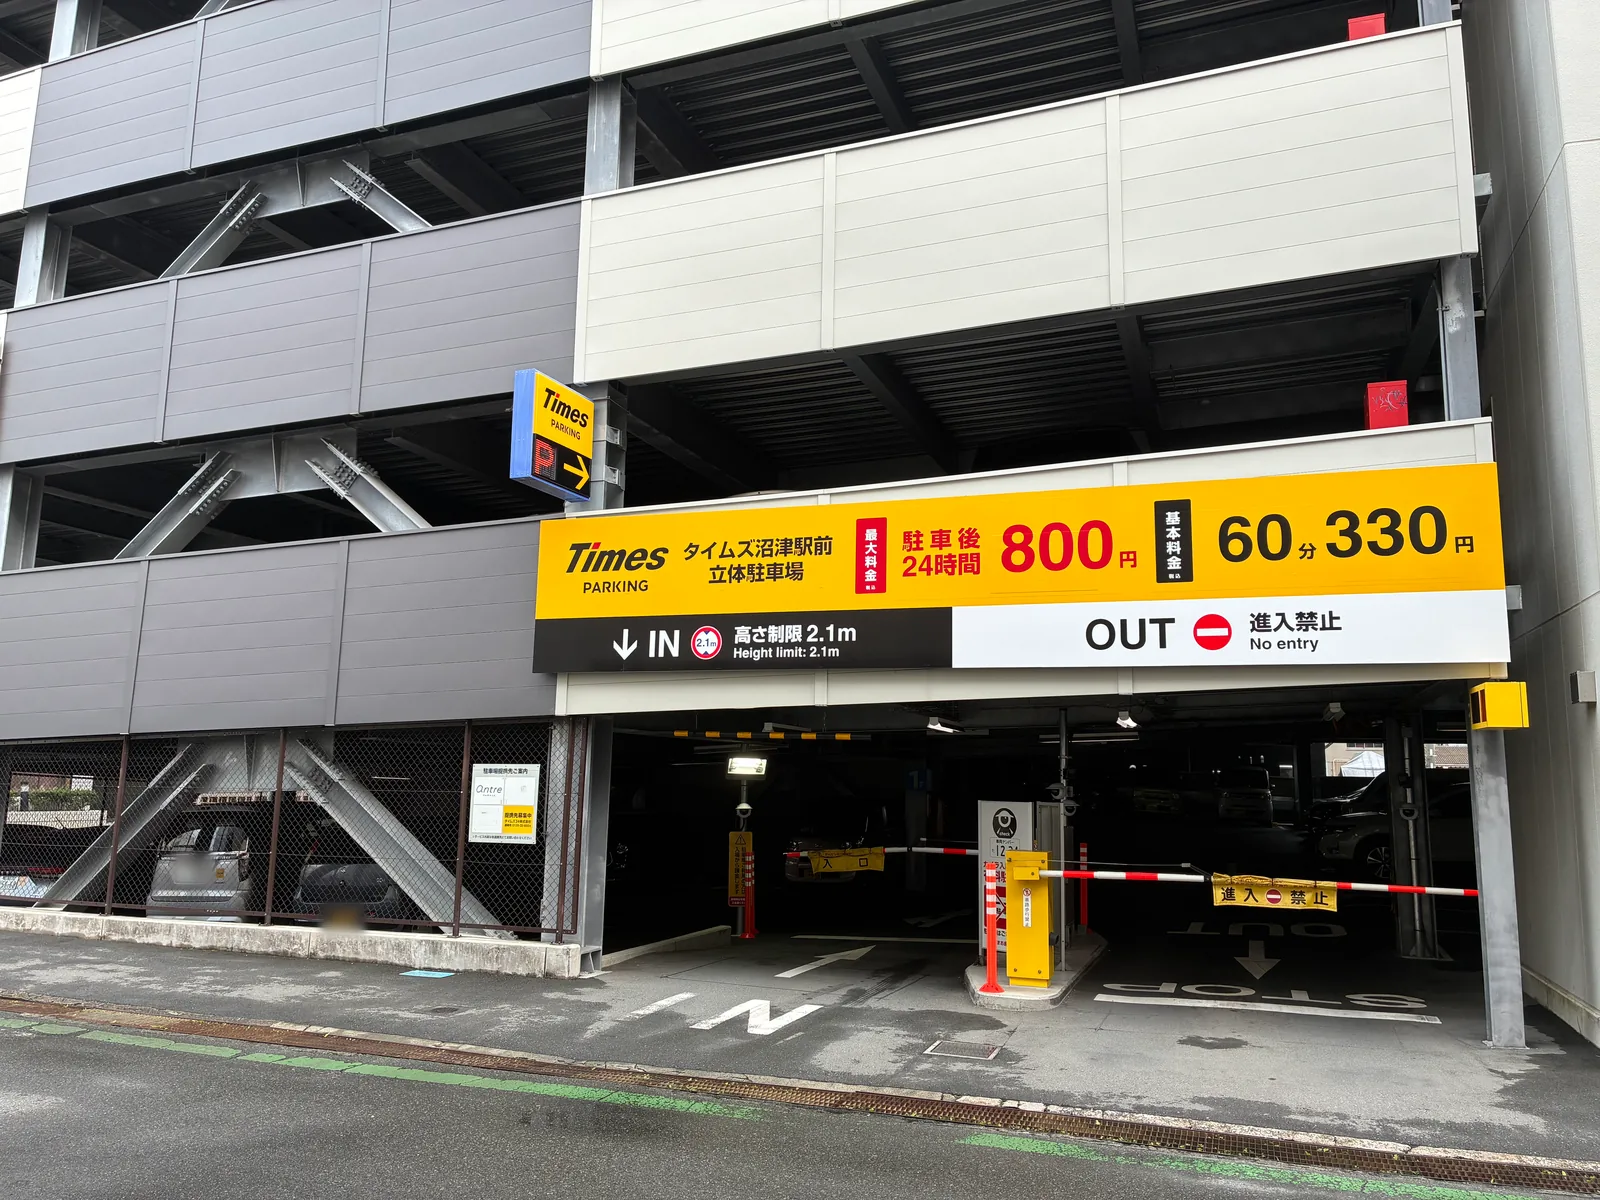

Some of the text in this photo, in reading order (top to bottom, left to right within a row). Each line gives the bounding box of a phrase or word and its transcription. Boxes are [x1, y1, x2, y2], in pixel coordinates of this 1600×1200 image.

[544, 388, 589, 428] Times
[551, 418, 581, 440] PARKING
[534, 438, 554, 475] P
[683, 536, 833, 561] タイムズ沼津駅前
[902, 527, 981, 552] 駐車後
[1165, 511, 1182, 570] 基本料金
[566, 542, 669, 574] Times
[864, 528, 878, 582] 最大料金
[902, 552, 981, 577] 24時間
[708, 562, 804, 585] 立体駐車場
[583, 580, 649, 594] PARKING
[733, 623, 857, 644] 高さ制限 2.1m
[1086, 617, 1176, 651] OUT
[1250, 610, 1343, 633] 進入禁止
[648, 629, 681, 658] IN
[696, 637, 717, 647] 2.1m
[733, 646, 840, 661] Height limit: 2.1m
[1250, 637, 1319, 653] No entry
[823, 857, 868, 869] 入口
[1102, 982, 1428, 1009] STOP
